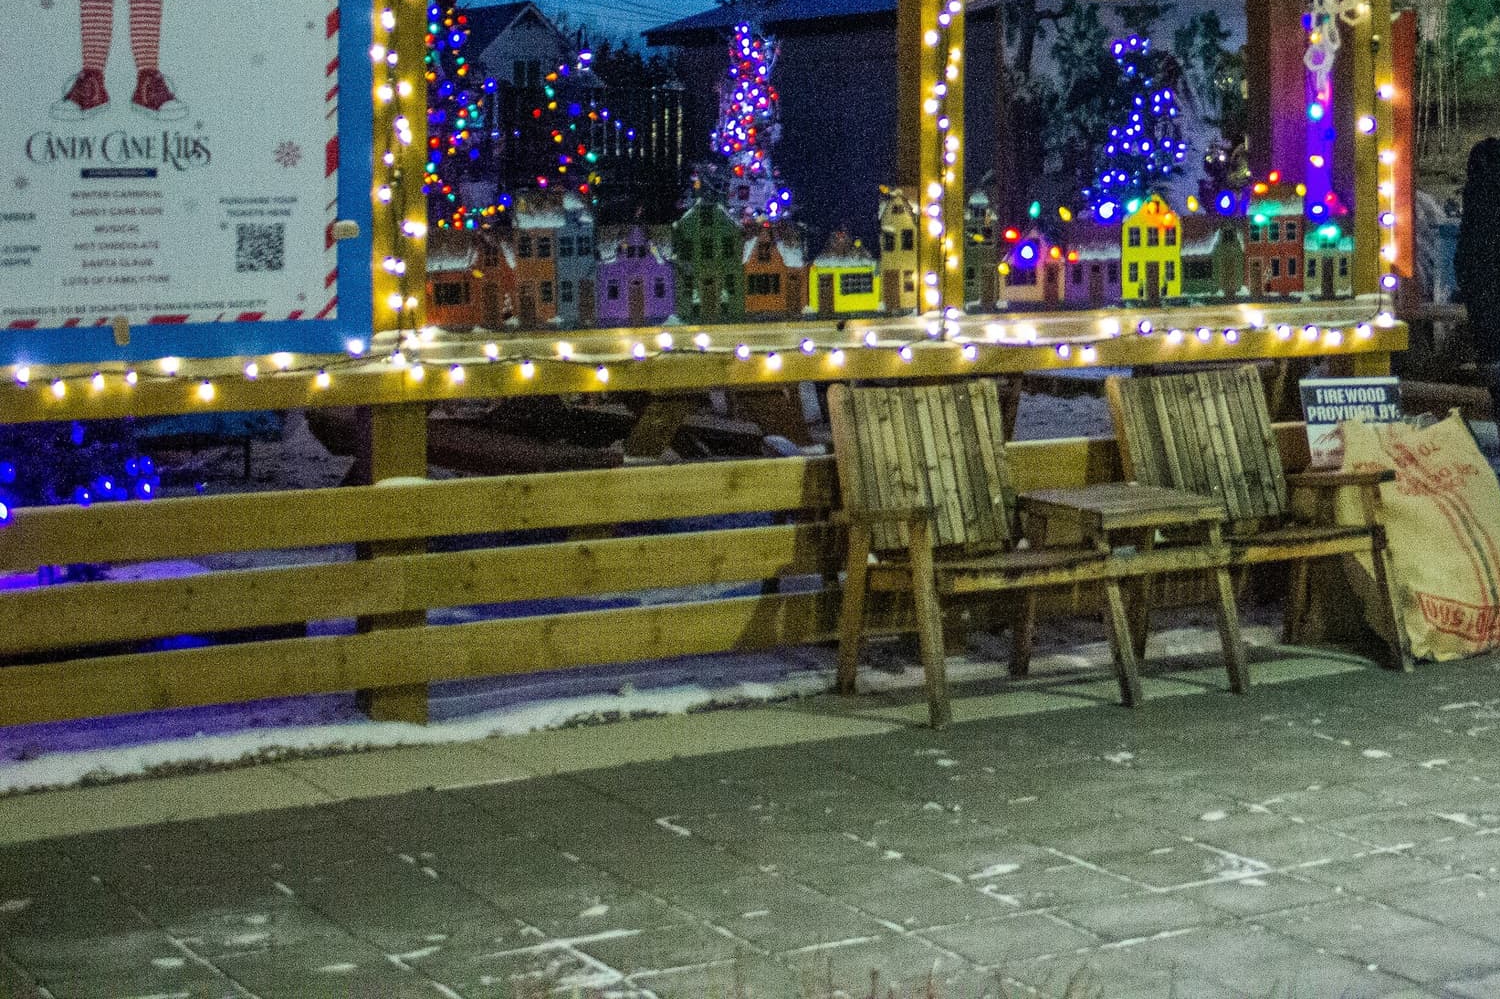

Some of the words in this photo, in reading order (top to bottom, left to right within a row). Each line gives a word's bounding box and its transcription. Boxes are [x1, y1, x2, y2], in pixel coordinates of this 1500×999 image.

[24, 130, 97, 165] CANDY
[100, 130, 157, 165] CANE
[161, 130, 213, 172] KIDS
[1315, 386, 1386, 404] FIREWOOD
